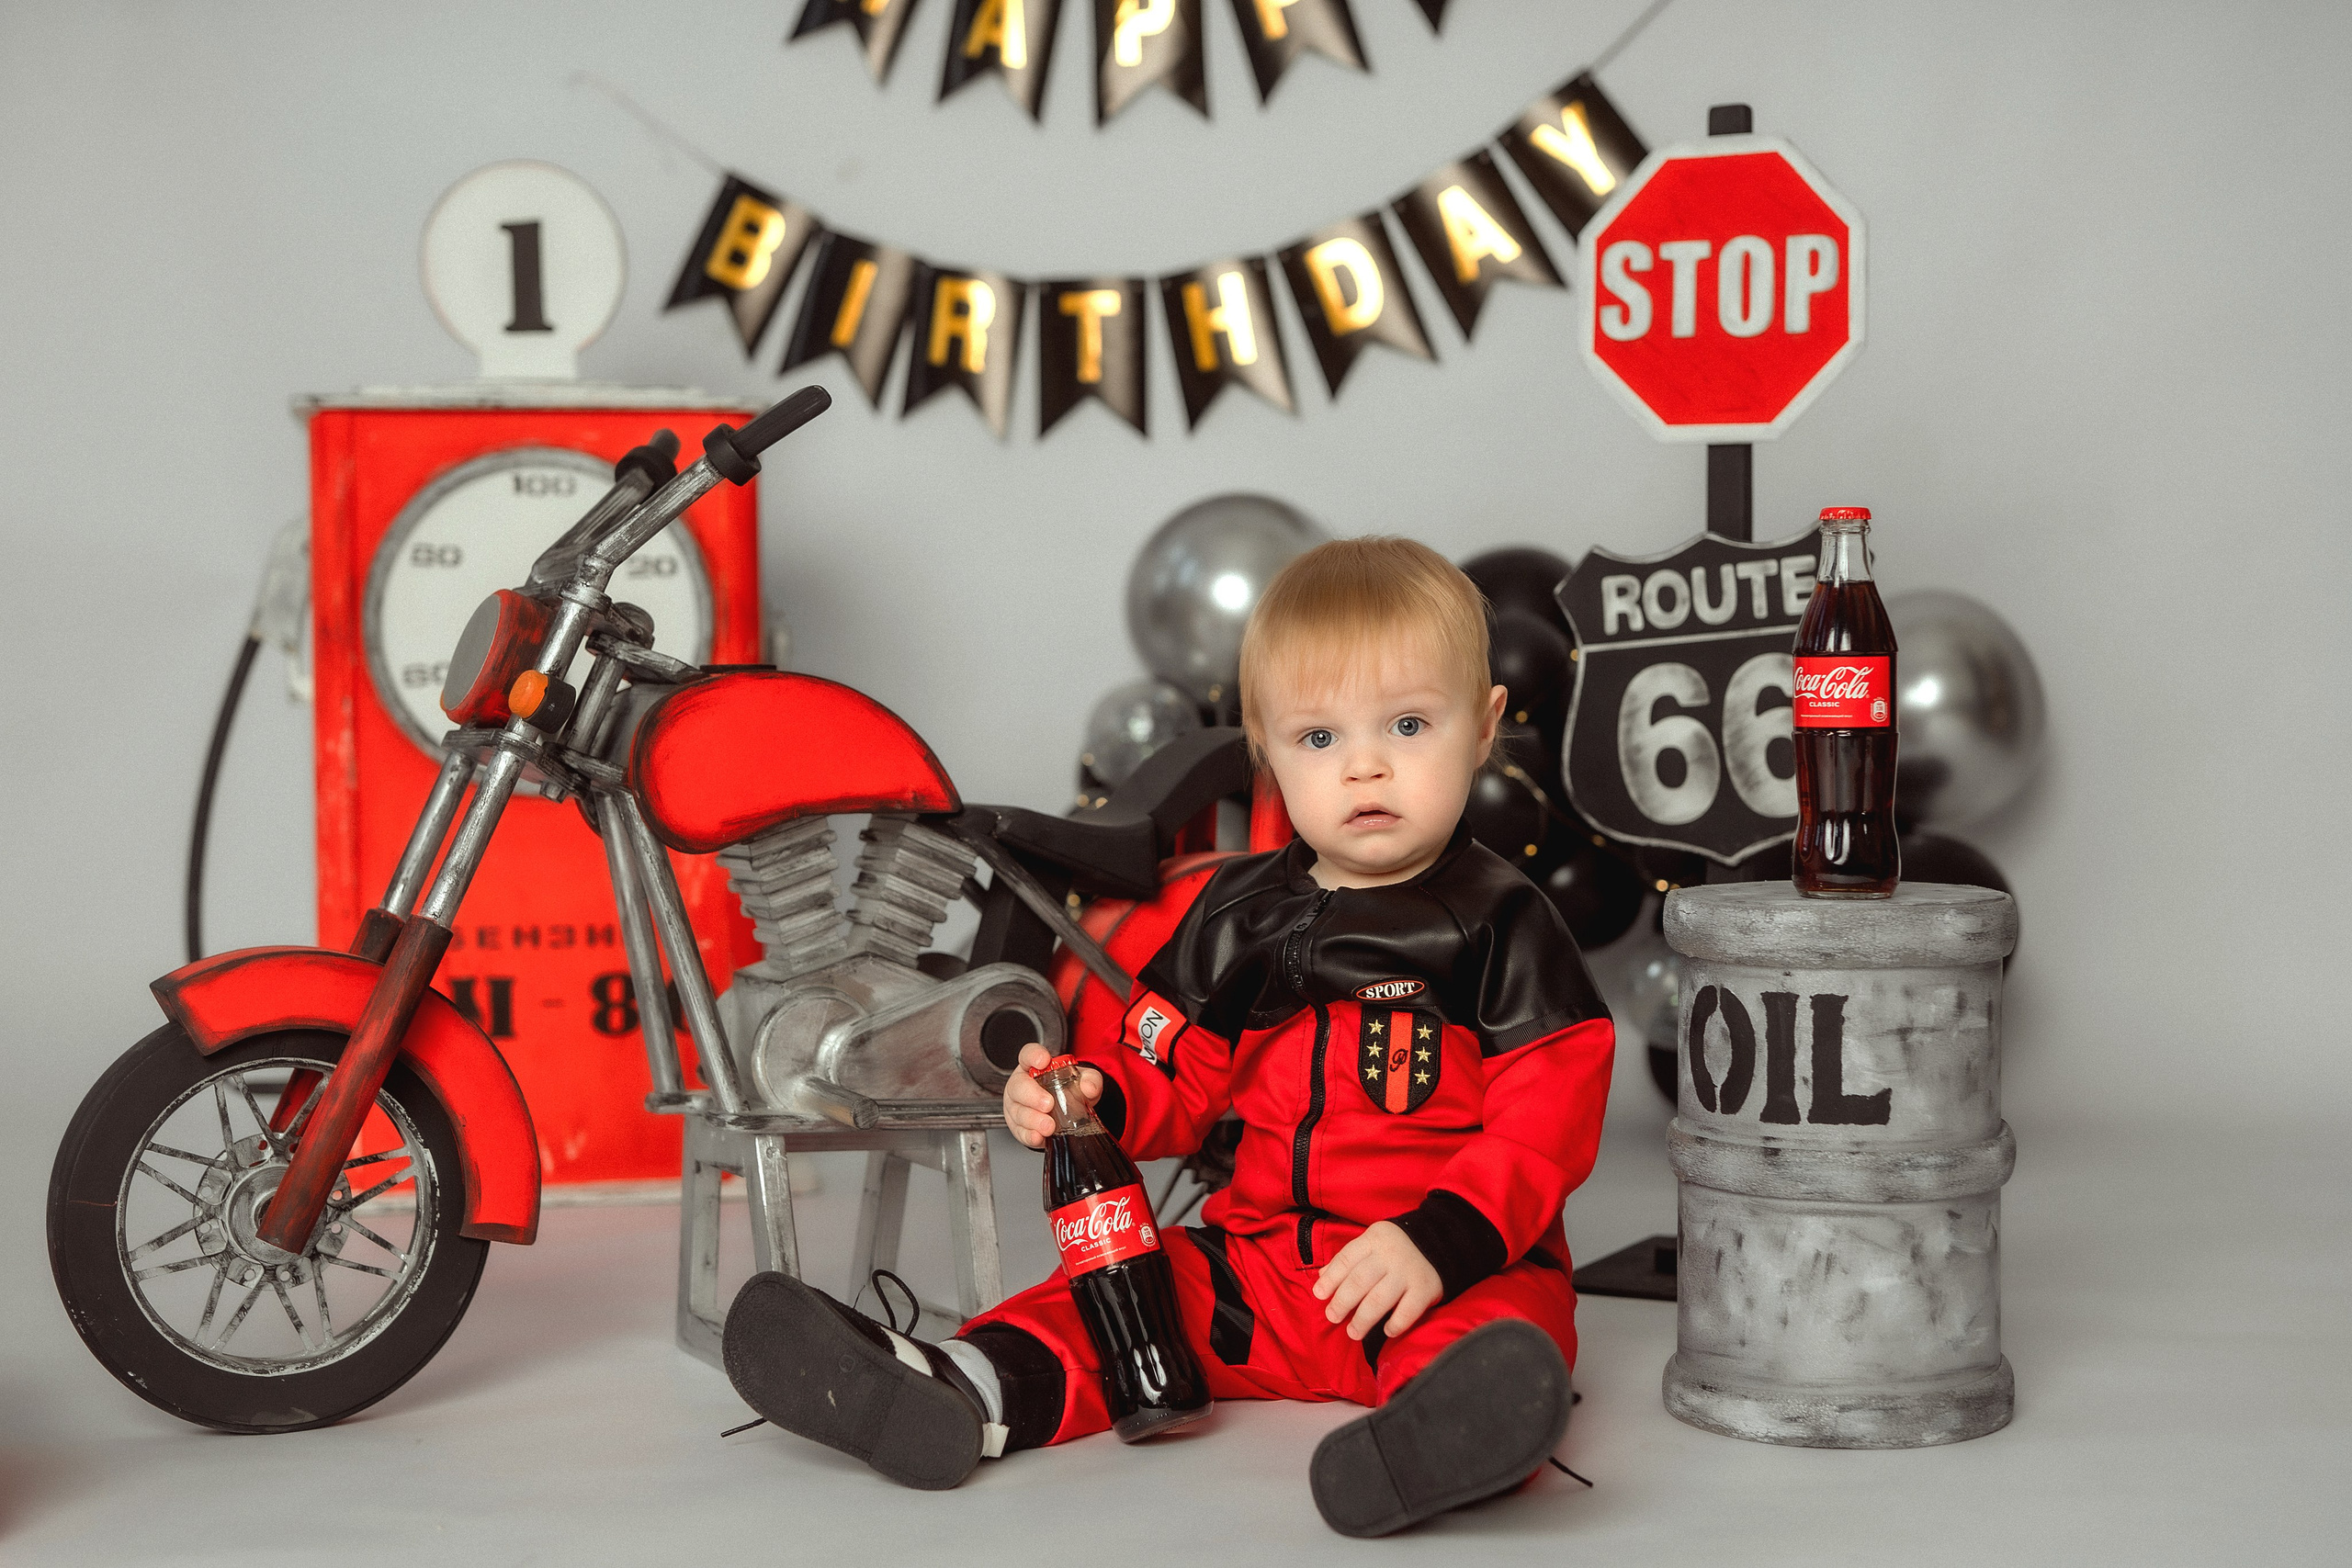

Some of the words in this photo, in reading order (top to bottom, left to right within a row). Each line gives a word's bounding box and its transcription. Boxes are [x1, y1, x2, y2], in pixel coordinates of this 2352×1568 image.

[500, 220, 553, 332] 1
[705, 102, 1615, 383] BIRTHDAY
[1600, 233, 1839, 342] STOP
[514, 475, 577, 497] 100
[1601, 555, 1816, 636] ROUTE
[1794, 666, 1874, 699] Coca-Cola
[1618, 652, 1798, 825] 66
[1365, 981, 1416, 999] SPORT
[1690, 985, 1892, 1125] OIL
[1057, 1196, 1132, 1251] Coca-Cola
[1080, 1238, 1112, 1252] CLASSIC
